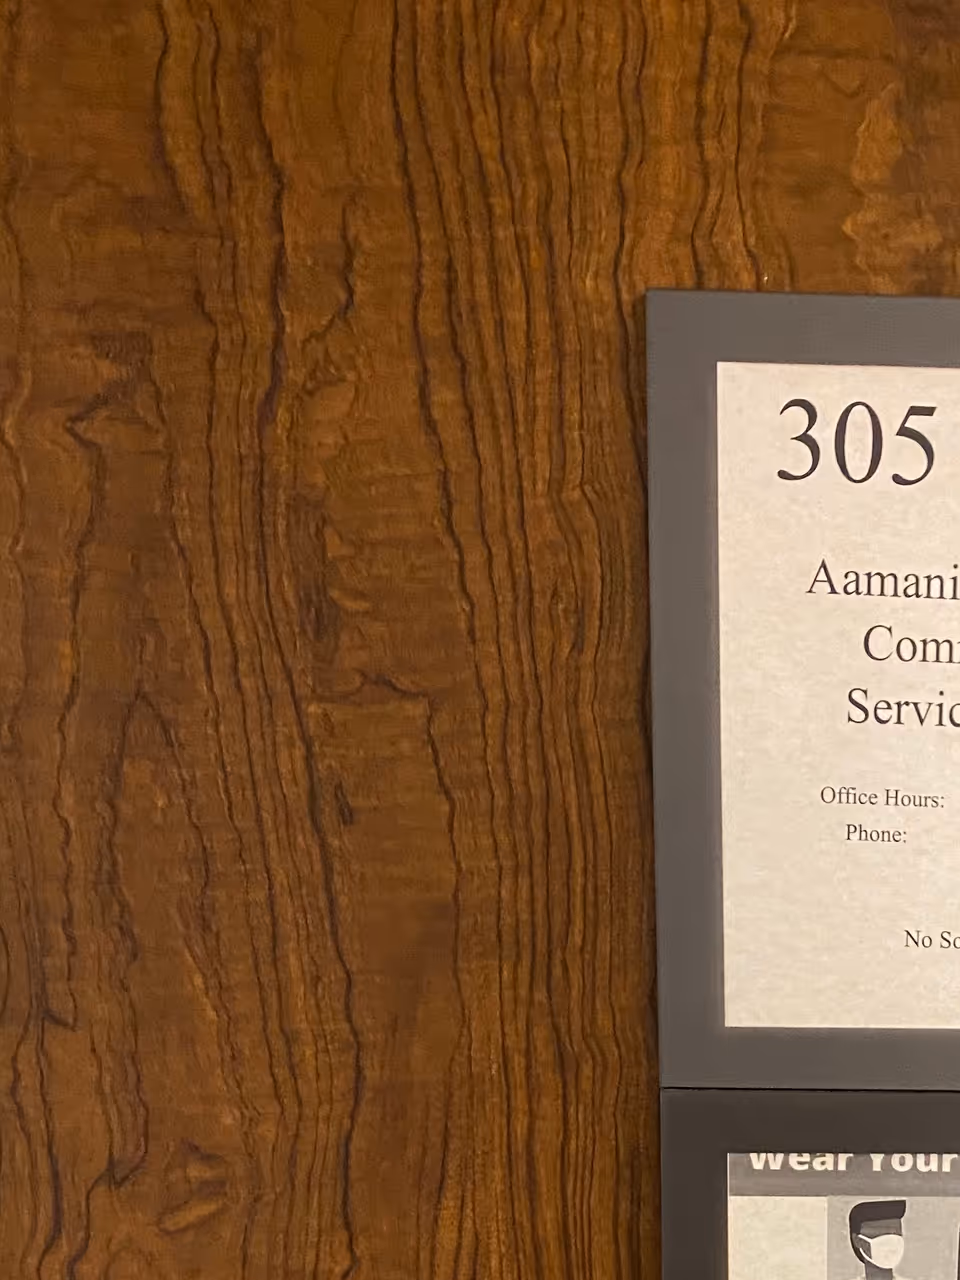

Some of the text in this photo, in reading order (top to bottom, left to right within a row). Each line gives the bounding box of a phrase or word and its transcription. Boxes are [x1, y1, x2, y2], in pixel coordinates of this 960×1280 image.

[777, 398, 937, 486] 305
[805, 559, 960, 601] Aamani
[820, 786, 878, 806] Office
[885, 789, 945, 809] Hours:
[846, 823, 907, 843] Phone:
[904, 929, 933, 949] No
[750, 1153, 854, 1172] Wear
[870, 1153, 959, 1173] Your
